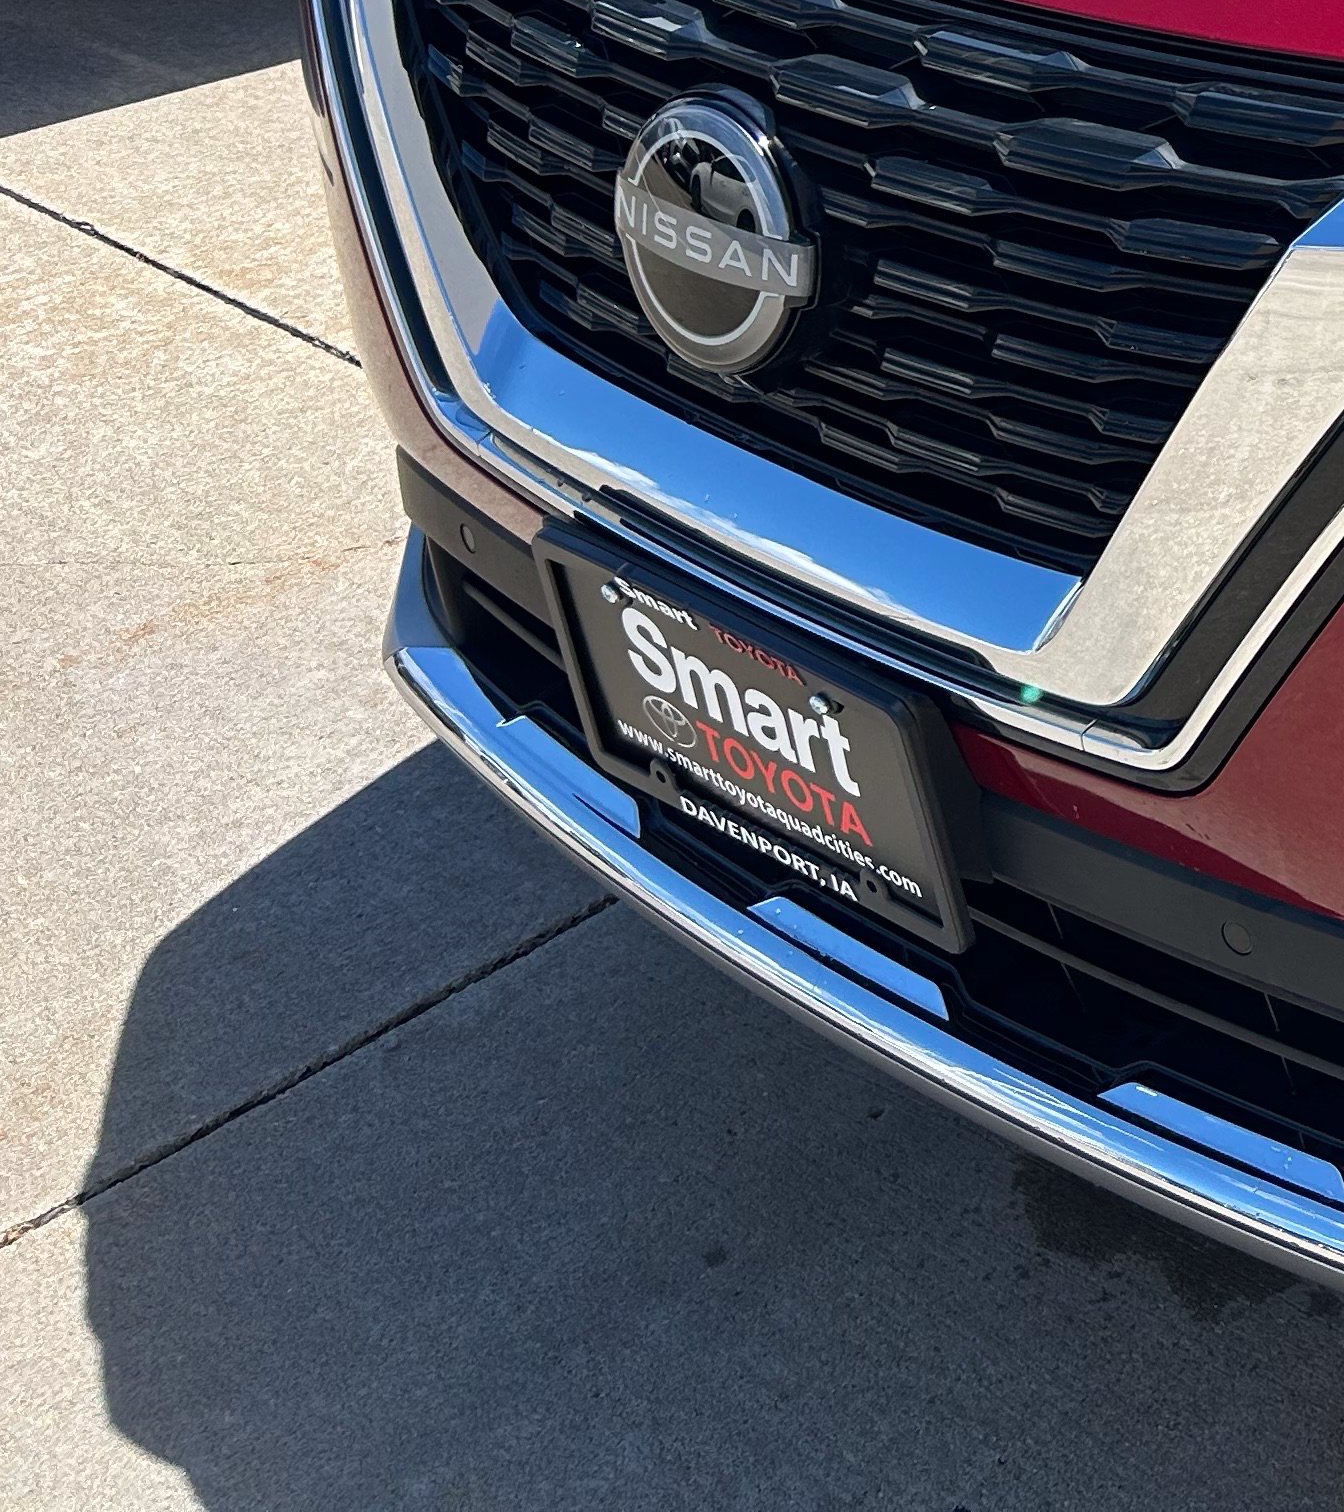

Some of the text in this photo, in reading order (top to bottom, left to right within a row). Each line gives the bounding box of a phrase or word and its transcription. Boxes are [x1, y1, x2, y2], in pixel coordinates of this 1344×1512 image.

[616, 188, 799, 287] NISSAN
[616, 576, 804, 686] Smart TOYOTA
[620, 608, 861, 797] Smart
[617, 719, 923, 897] www.smarttoyotaquadcities.com
[696, 720, 873, 846] TOYOTA
[679, 796, 860, 902] DAVENPORT, IA
